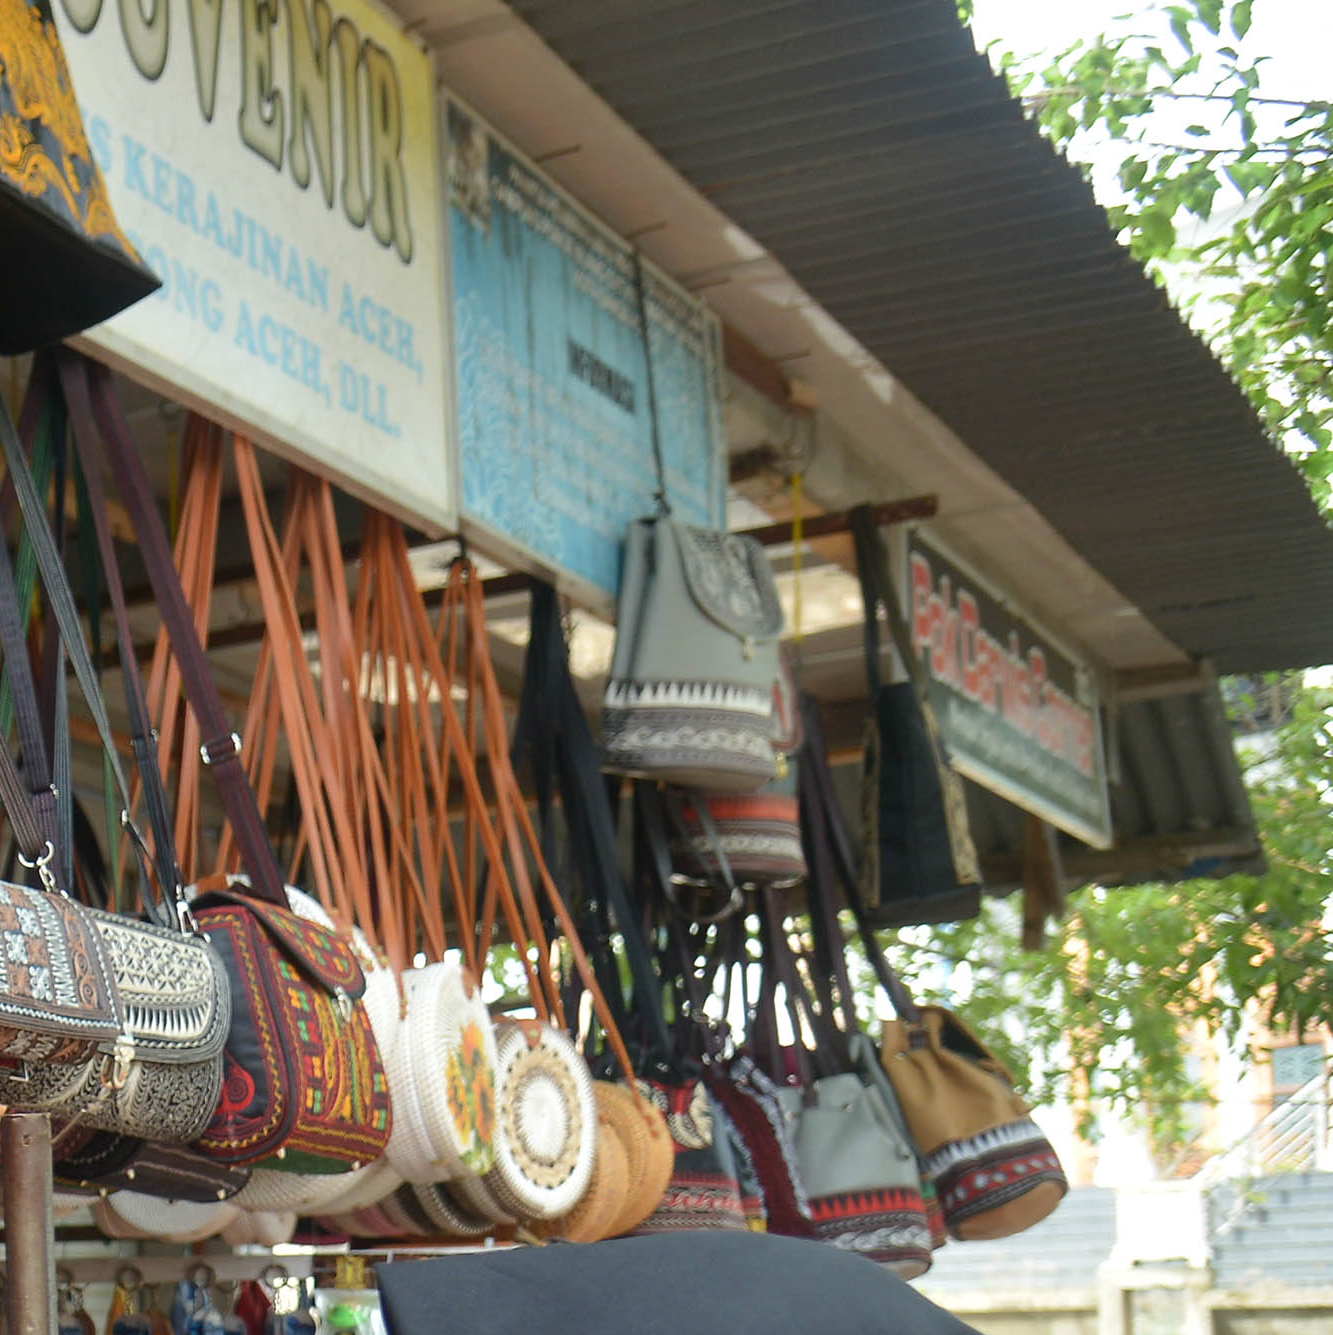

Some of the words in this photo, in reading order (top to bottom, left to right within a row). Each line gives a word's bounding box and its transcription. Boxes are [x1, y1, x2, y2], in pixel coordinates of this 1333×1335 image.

[122, 134, 330, 312] KERAJINAN
[340, 283, 423, 383] ACEH,
[128, 228, 225, 333] ONG
[234, 300, 332, 408] ACEH,
[340, 361, 402, 438] DLL.
